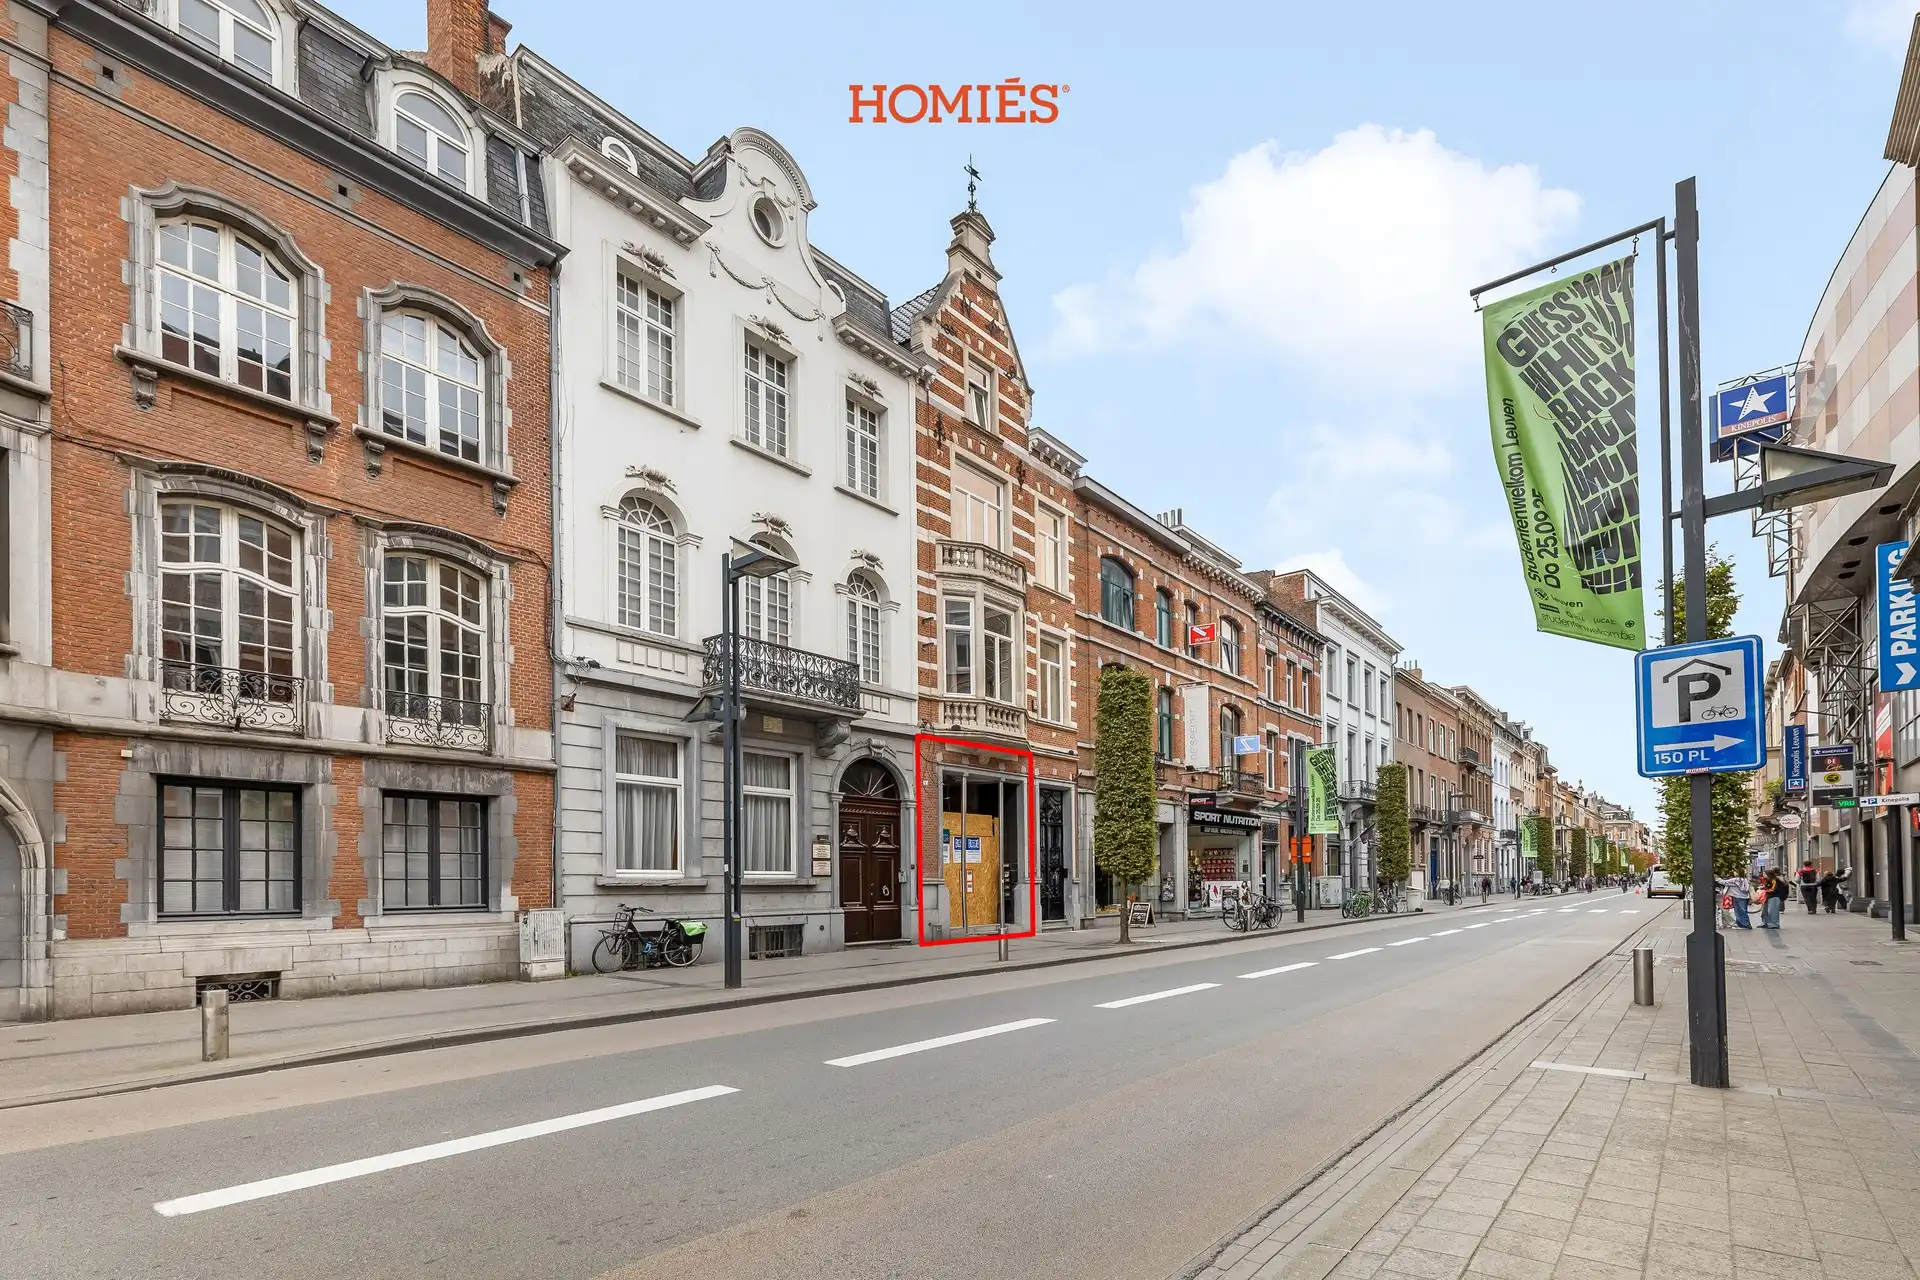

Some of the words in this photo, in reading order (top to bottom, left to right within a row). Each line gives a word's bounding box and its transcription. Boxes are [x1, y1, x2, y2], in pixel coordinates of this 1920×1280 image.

[1518, 322, 1616, 403] WHO'S
[1502, 398, 1520, 447] Leuven
[1731, 415, 1777, 431] KINEPOLIS
[1506, 452, 1542, 582] Studentenwelkom
[1544, 563, 1560, 588] Do
[1677, 672, 1721, 723] P
[1791, 727, 1800, 749] Leuven
[1655, 752, 1683, 765] 150
[1689, 750, 1711, 762] PL
[1791, 750, 1802, 777] Kinepolis
[1881, 796, 1910, 804] Kinepolis
[1193, 810, 1222, 823] SPORT
[1223, 814, 1261, 827] NUTRITION
